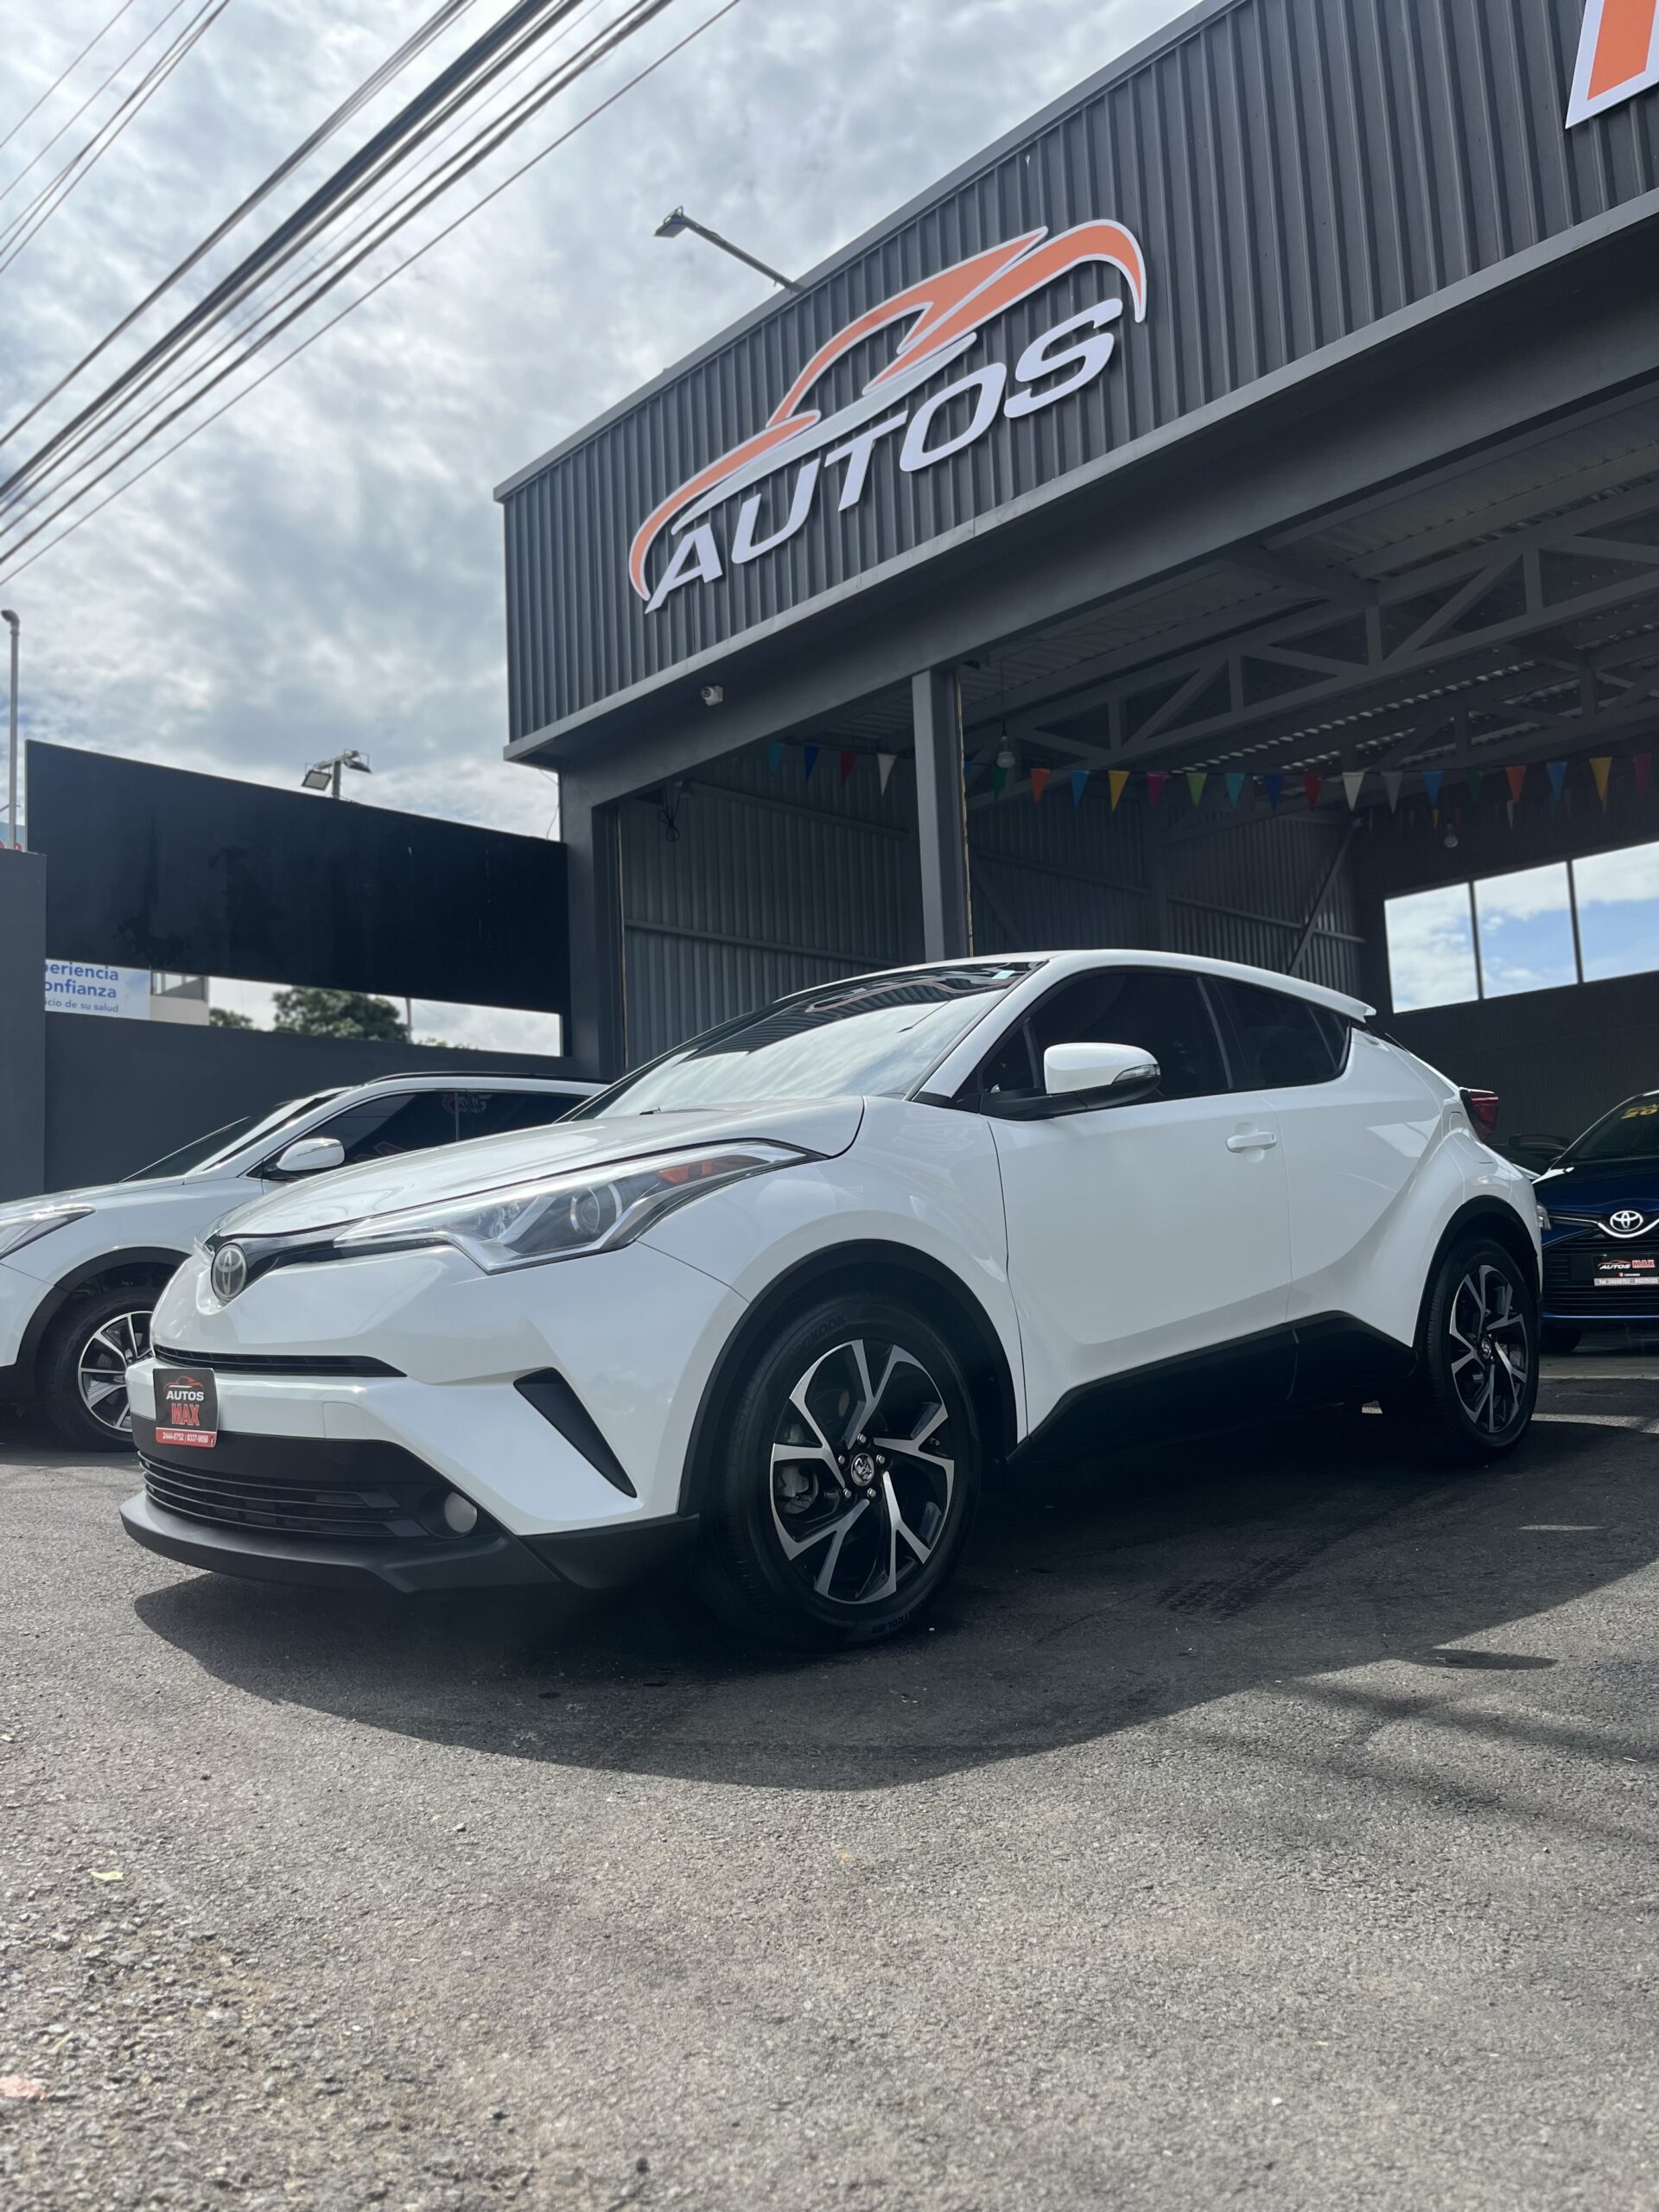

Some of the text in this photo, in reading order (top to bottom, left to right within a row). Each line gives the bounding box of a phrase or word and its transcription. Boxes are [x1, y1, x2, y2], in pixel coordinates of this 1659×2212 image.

[644, 297, 1123, 614] AUTOS
[65, 999, 77, 1008] de
[94, 1003, 118, 1013] salud
[1631, 1259, 1656, 1268] MAX
[166, 1390, 205, 1402] AUTOS
[171, 1403, 200, 1427] MAX
